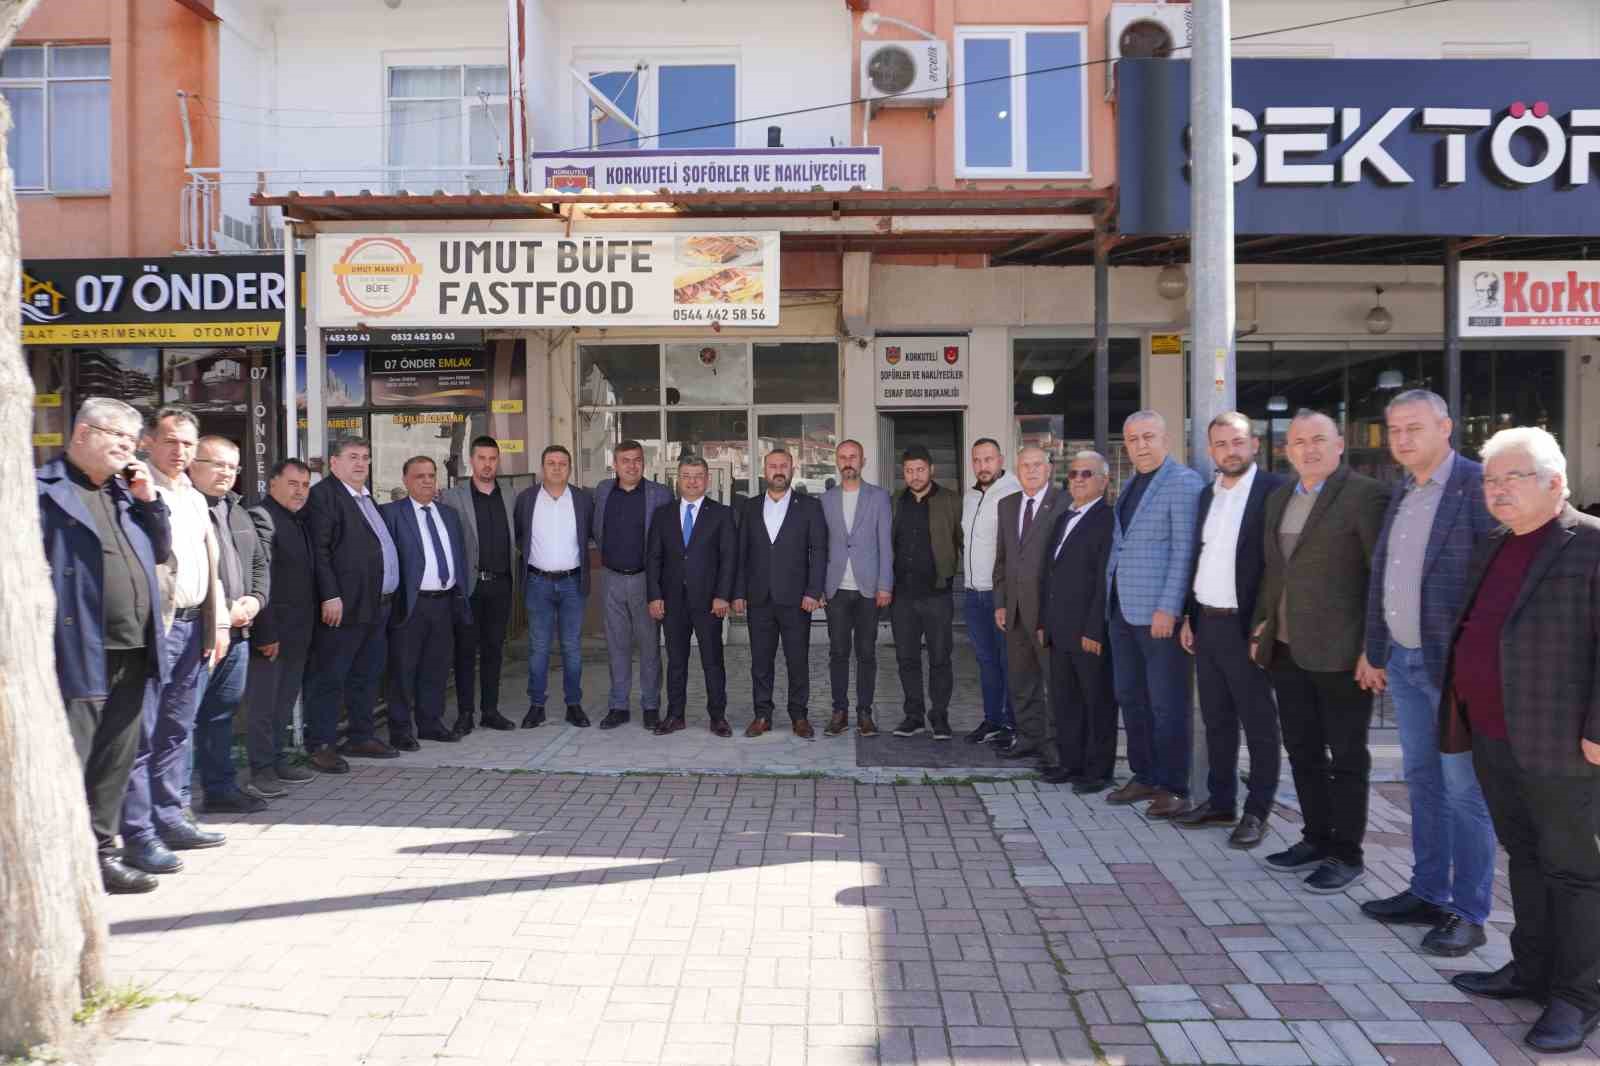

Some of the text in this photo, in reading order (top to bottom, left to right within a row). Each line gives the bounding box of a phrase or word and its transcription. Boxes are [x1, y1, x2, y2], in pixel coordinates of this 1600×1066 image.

[607, 160, 866, 186] KORKUTELİ ŞOFÖRLER VE NAKLİYECİLER
[439, 236, 653, 273] UMUT BÜFE
[75, 265, 286, 313] 07 ÖNDER
[366, 284, 390, 293] BÜFE
[439, 281, 634, 315] FASTFOOD
[673, 309, 766, 321] 0544 442 58 56
[71, 327, 177, 339] GAYRİMENKUL
[193, 325, 270, 338] OTOMOTİV
[905, 351, 938, 361] KORKUTELİ
[384, 357, 471, 369] 07 ÖNDER EMLAK
[250, 367, 268, 380] 07
[912, 370, 920, 380] VE
